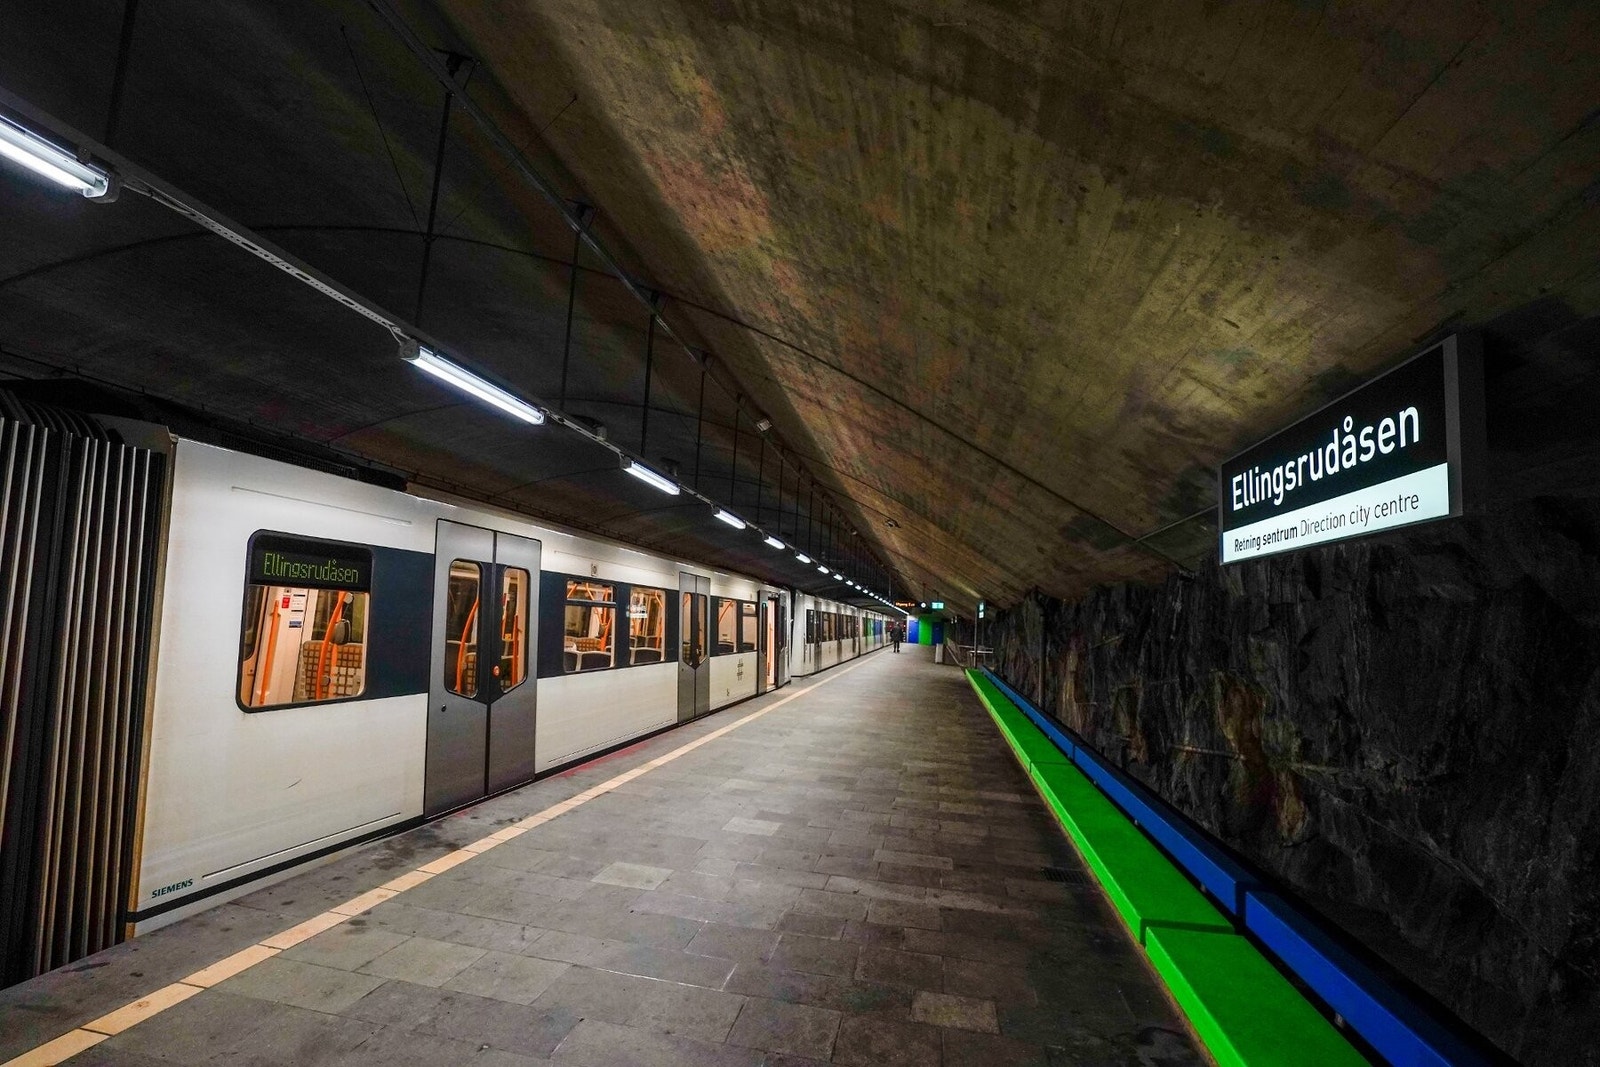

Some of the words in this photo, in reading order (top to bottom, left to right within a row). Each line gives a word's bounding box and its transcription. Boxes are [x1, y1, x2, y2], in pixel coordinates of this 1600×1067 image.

[1232, 405, 1420, 511] Ellingsrudåsen
[1234, 534, 1261, 552] Retning
[1262, 526, 1298, 546] sentrum
[1300, 511, 1346, 536] Direction
[1349, 505, 1371, 527] city
[1374, 494, 1420, 519] centre
[263, 552, 359, 583] Ellingsrudåsen
[151, 879, 193, 899] SIEMENS
